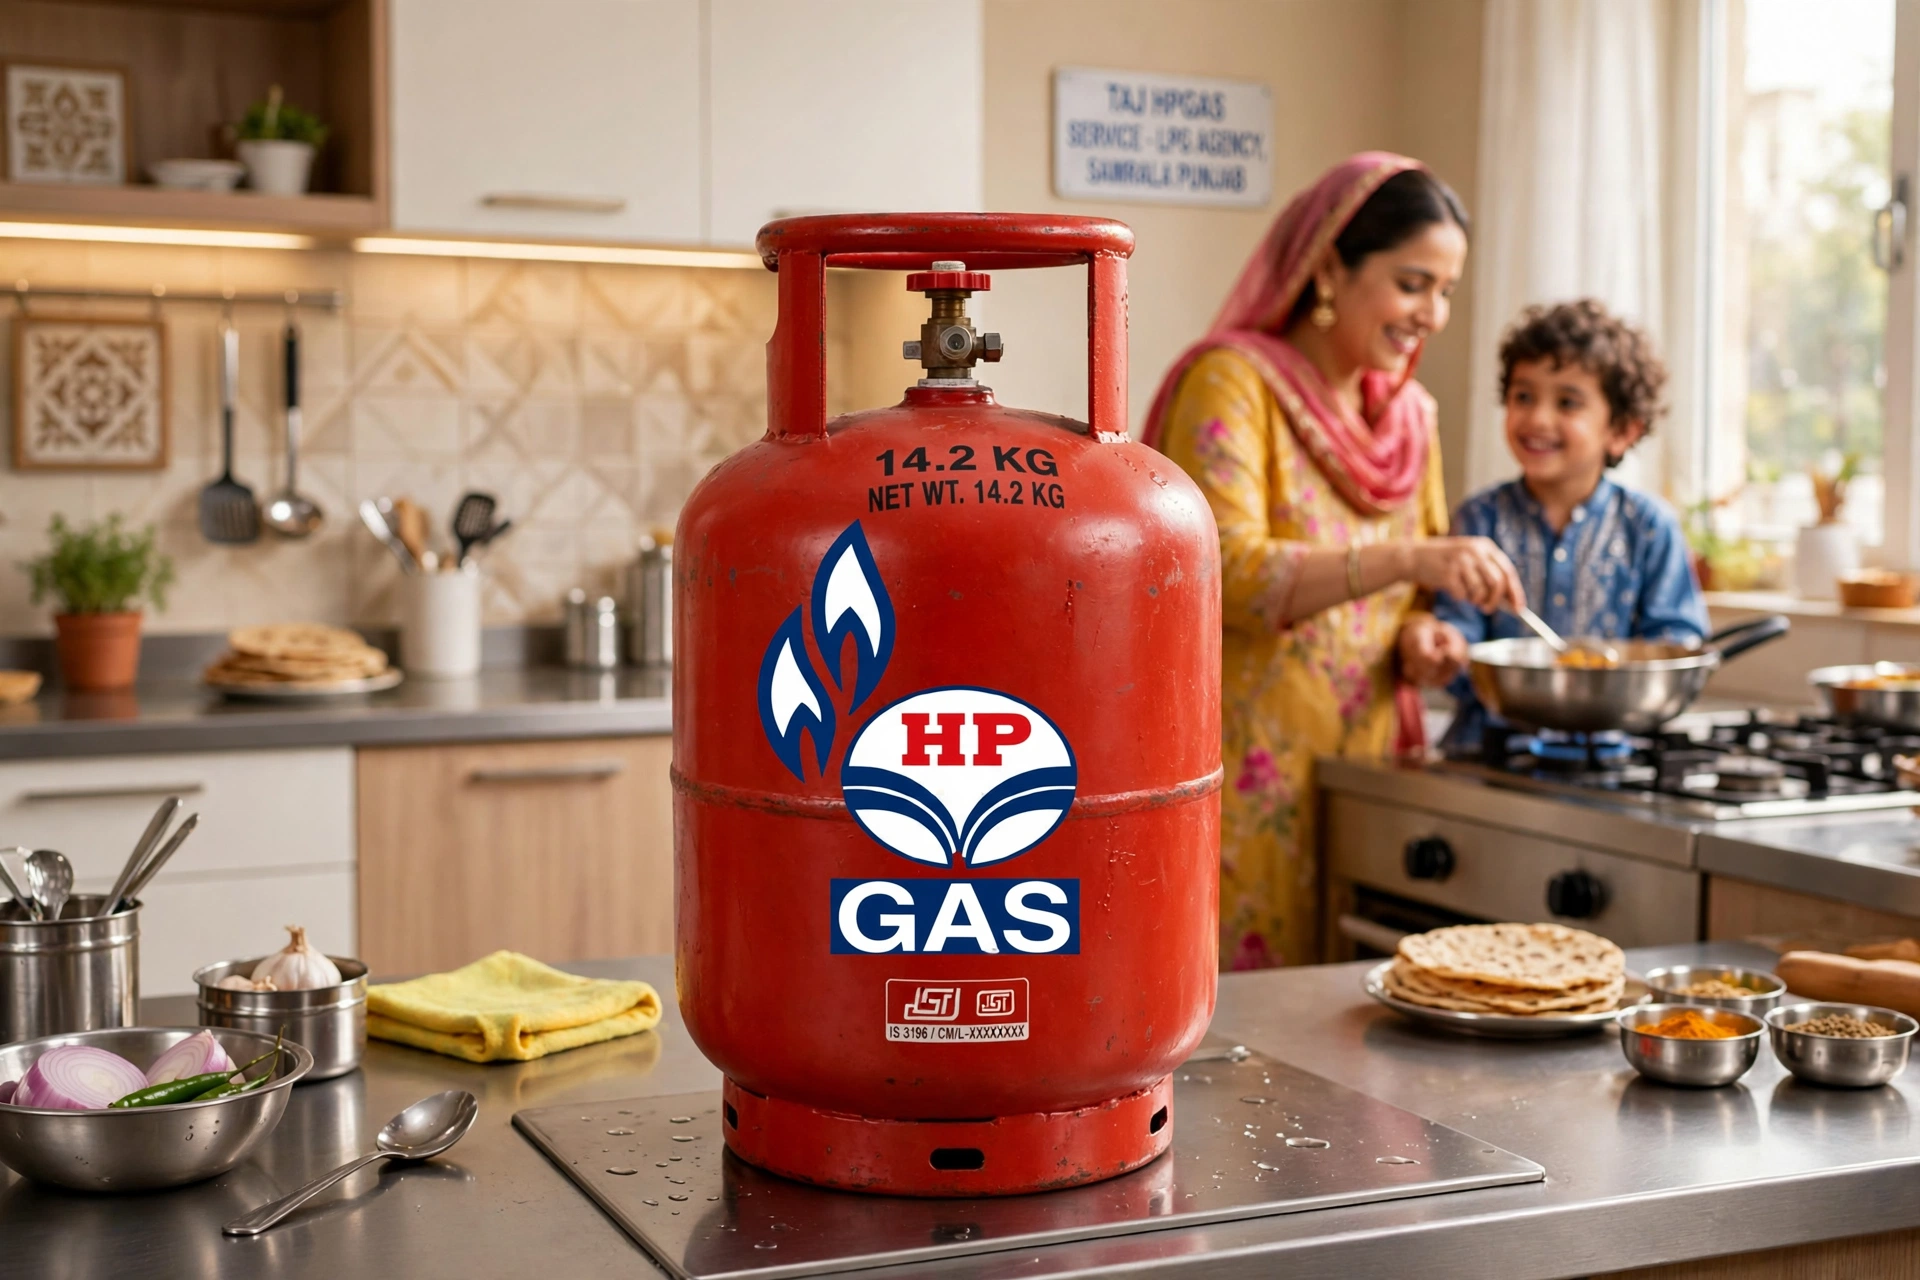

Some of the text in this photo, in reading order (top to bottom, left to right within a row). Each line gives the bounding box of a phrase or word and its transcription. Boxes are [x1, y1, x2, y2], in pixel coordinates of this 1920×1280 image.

[1106, 82, 1147, 115] TAJ
[1068, 121, 1141, 150] SERVICE
[1157, 125, 1193, 153] LPG
[1177, 163, 1247, 193] PUNJAB
[876, 445, 1059, 477] 14.2 KG
[868, 479, 1065, 513] NET WT. 14.2 KG
[901, 713, 1032, 766] HP
[838, 880, 1071, 954] GAS
[889, 1026, 900, 1039] IS
[903, 1026, 928, 1039] 3196
